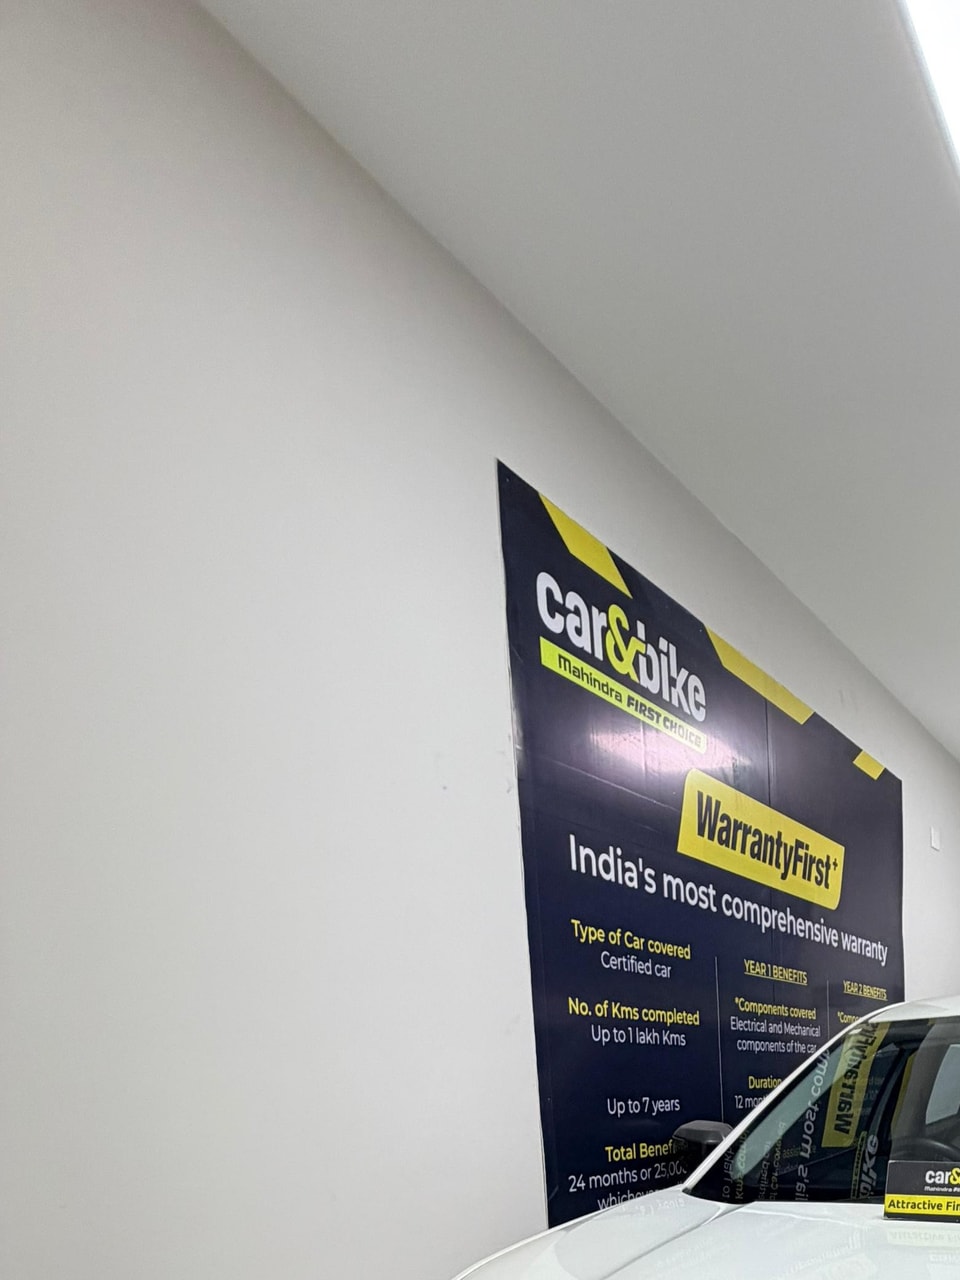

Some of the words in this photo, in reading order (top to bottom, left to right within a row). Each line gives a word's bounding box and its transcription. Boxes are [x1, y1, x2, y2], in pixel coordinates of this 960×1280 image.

[536, 571, 707, 722] car&bike
[626, 695, 663, 725] FIRST
[663, 715, 703, 748] CHOICE
[569, 834, 657, 894] India's
[662, 873, 718, 913] most
[721, 893, 839, 948] comprehensive
[841, 931, 888, 967] warranty
[571, 919, 606, 944] Type
[608, 928, 622, 946] of
[624, 931, 645, 951] Car
[647, 940, 691, 960] covered
[600, 951, 653, 975] Certified
[654, 964, 672, 978] car
[744, 958, 767, 976] YEAR
[767, 963, 772, 977] 1
[772, 965, 808, 985] BENEFITS
[843, 980, 859, 993] YEAR
[863, 984, 888, 1000] BENEFITS
[568, 996, 592, 1016] No.
[595, 1000, 609, 1018] of
[611, 1001, 639, 1020] Kms
[641, 1008, 700, 1027] completed
[789, 1007, 817, 1020] covered
[591, 1024, 611, 1047] Up
[613, 1027, 626, 1044] to
[628, 1026, 633, 1044] 1
[635, 1027, 660, 1045] lakh
[662, 1029, 687, 1047] Kms
[730, 1016, 767, 1033] Electrical
[768, 1020, 783, 1034] and
[784, 1021, 821, 1038] Mechanical
[736, 1039, 786, 1055] components
[786, 1040, 795, 1053] of
[795, 1041, 806, 1053] the
[806, 1043, 817, 1054] car
[607, 1098, 626, 1118] Up
[628, 1098, 641, 1114] to
[642, 1097, 650, 1112] 7
[652, 1098, 681, 1116] years
[734, 1095, 744, 1109] 12
[604, 1142, 637, 1162] Total
[568, 1174, 586, 1193] 24
[588, 1167, 638, 1189] months
[640, 1167, 652, 1180] or
[888, 1199, 943, 1211] Attractive
